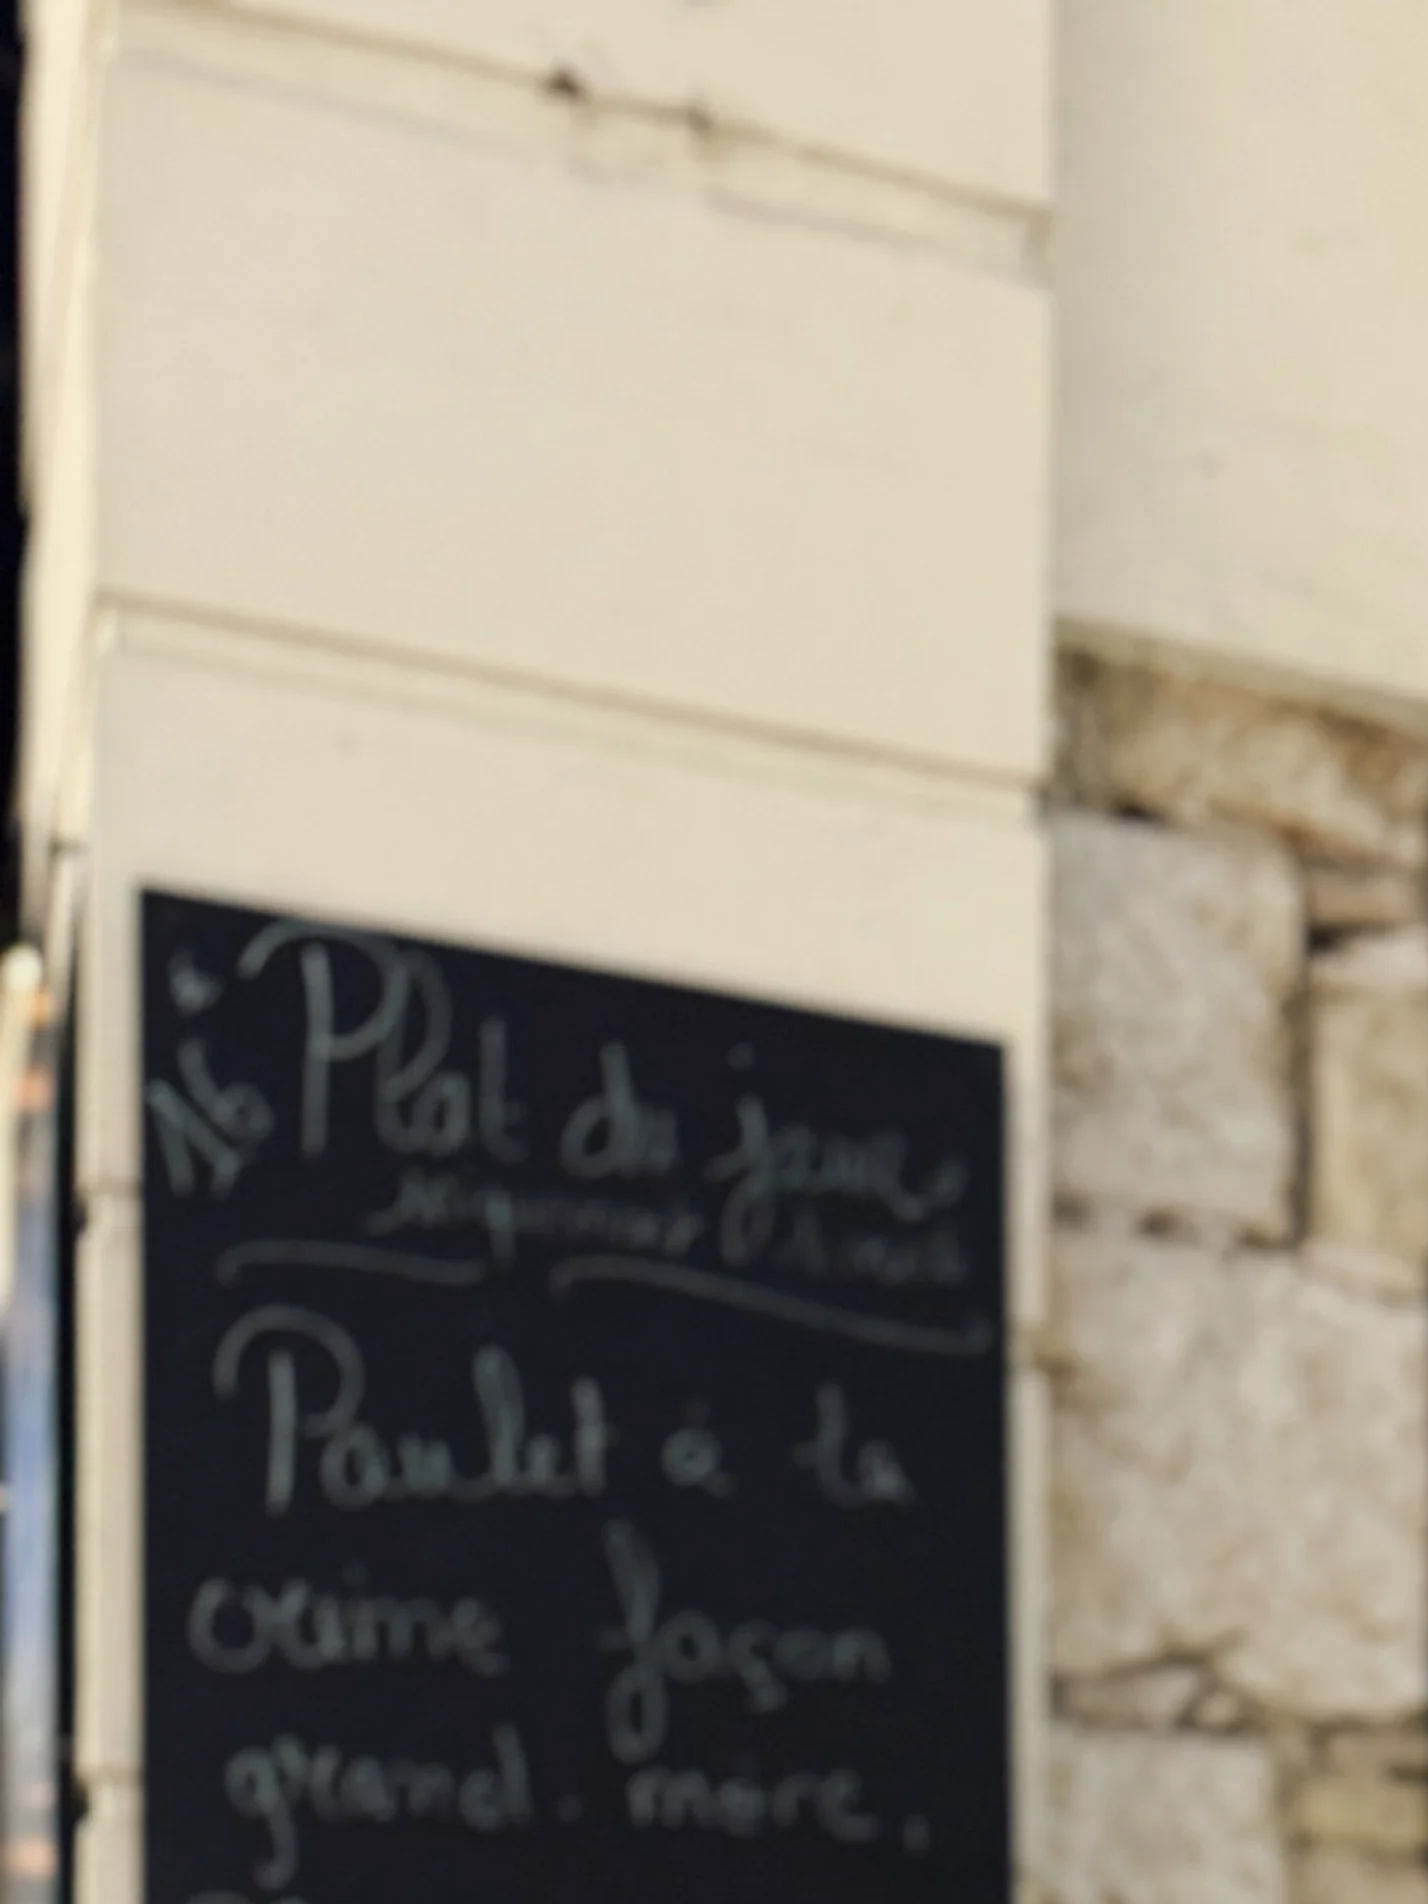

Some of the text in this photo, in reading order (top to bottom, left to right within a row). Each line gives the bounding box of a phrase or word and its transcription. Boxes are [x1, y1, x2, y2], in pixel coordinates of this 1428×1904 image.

[237, 917, 528, 1162] Plat
[561, 1043, 677, 1176] du
[213, 1304, 619, 1516] Poulet
[595, 1519, 892, 1762] façon
